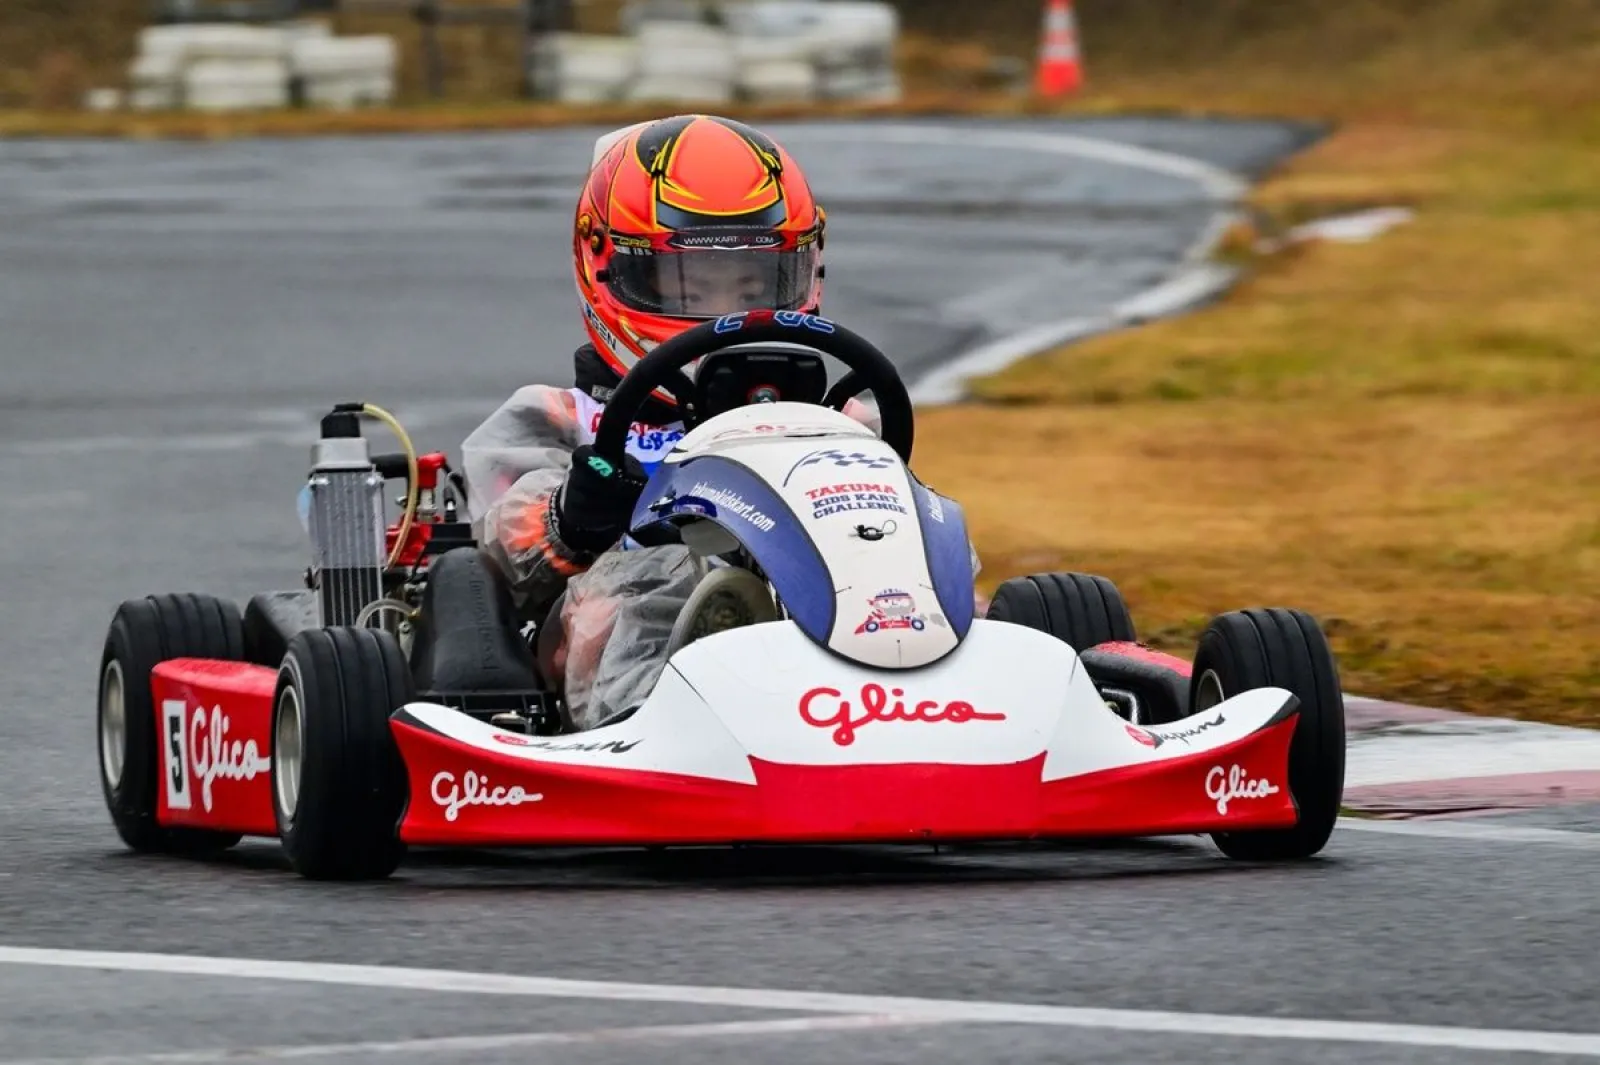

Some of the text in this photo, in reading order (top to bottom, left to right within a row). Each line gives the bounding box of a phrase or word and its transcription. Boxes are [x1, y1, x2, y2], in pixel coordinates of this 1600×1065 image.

[805, 483, 898, 499] TAKUMA
[812, 492, 899, 509] KIDS KART
[813, 501, 907, 519] CHALLENGE
[798, 683, 1006, 747] Glico
[169, 715, 184, 793] 5
[190, 704, 271, 814] Glico
[430, 770, 543, 822] Glico
[1205, 764, 1279, 815] Glico
